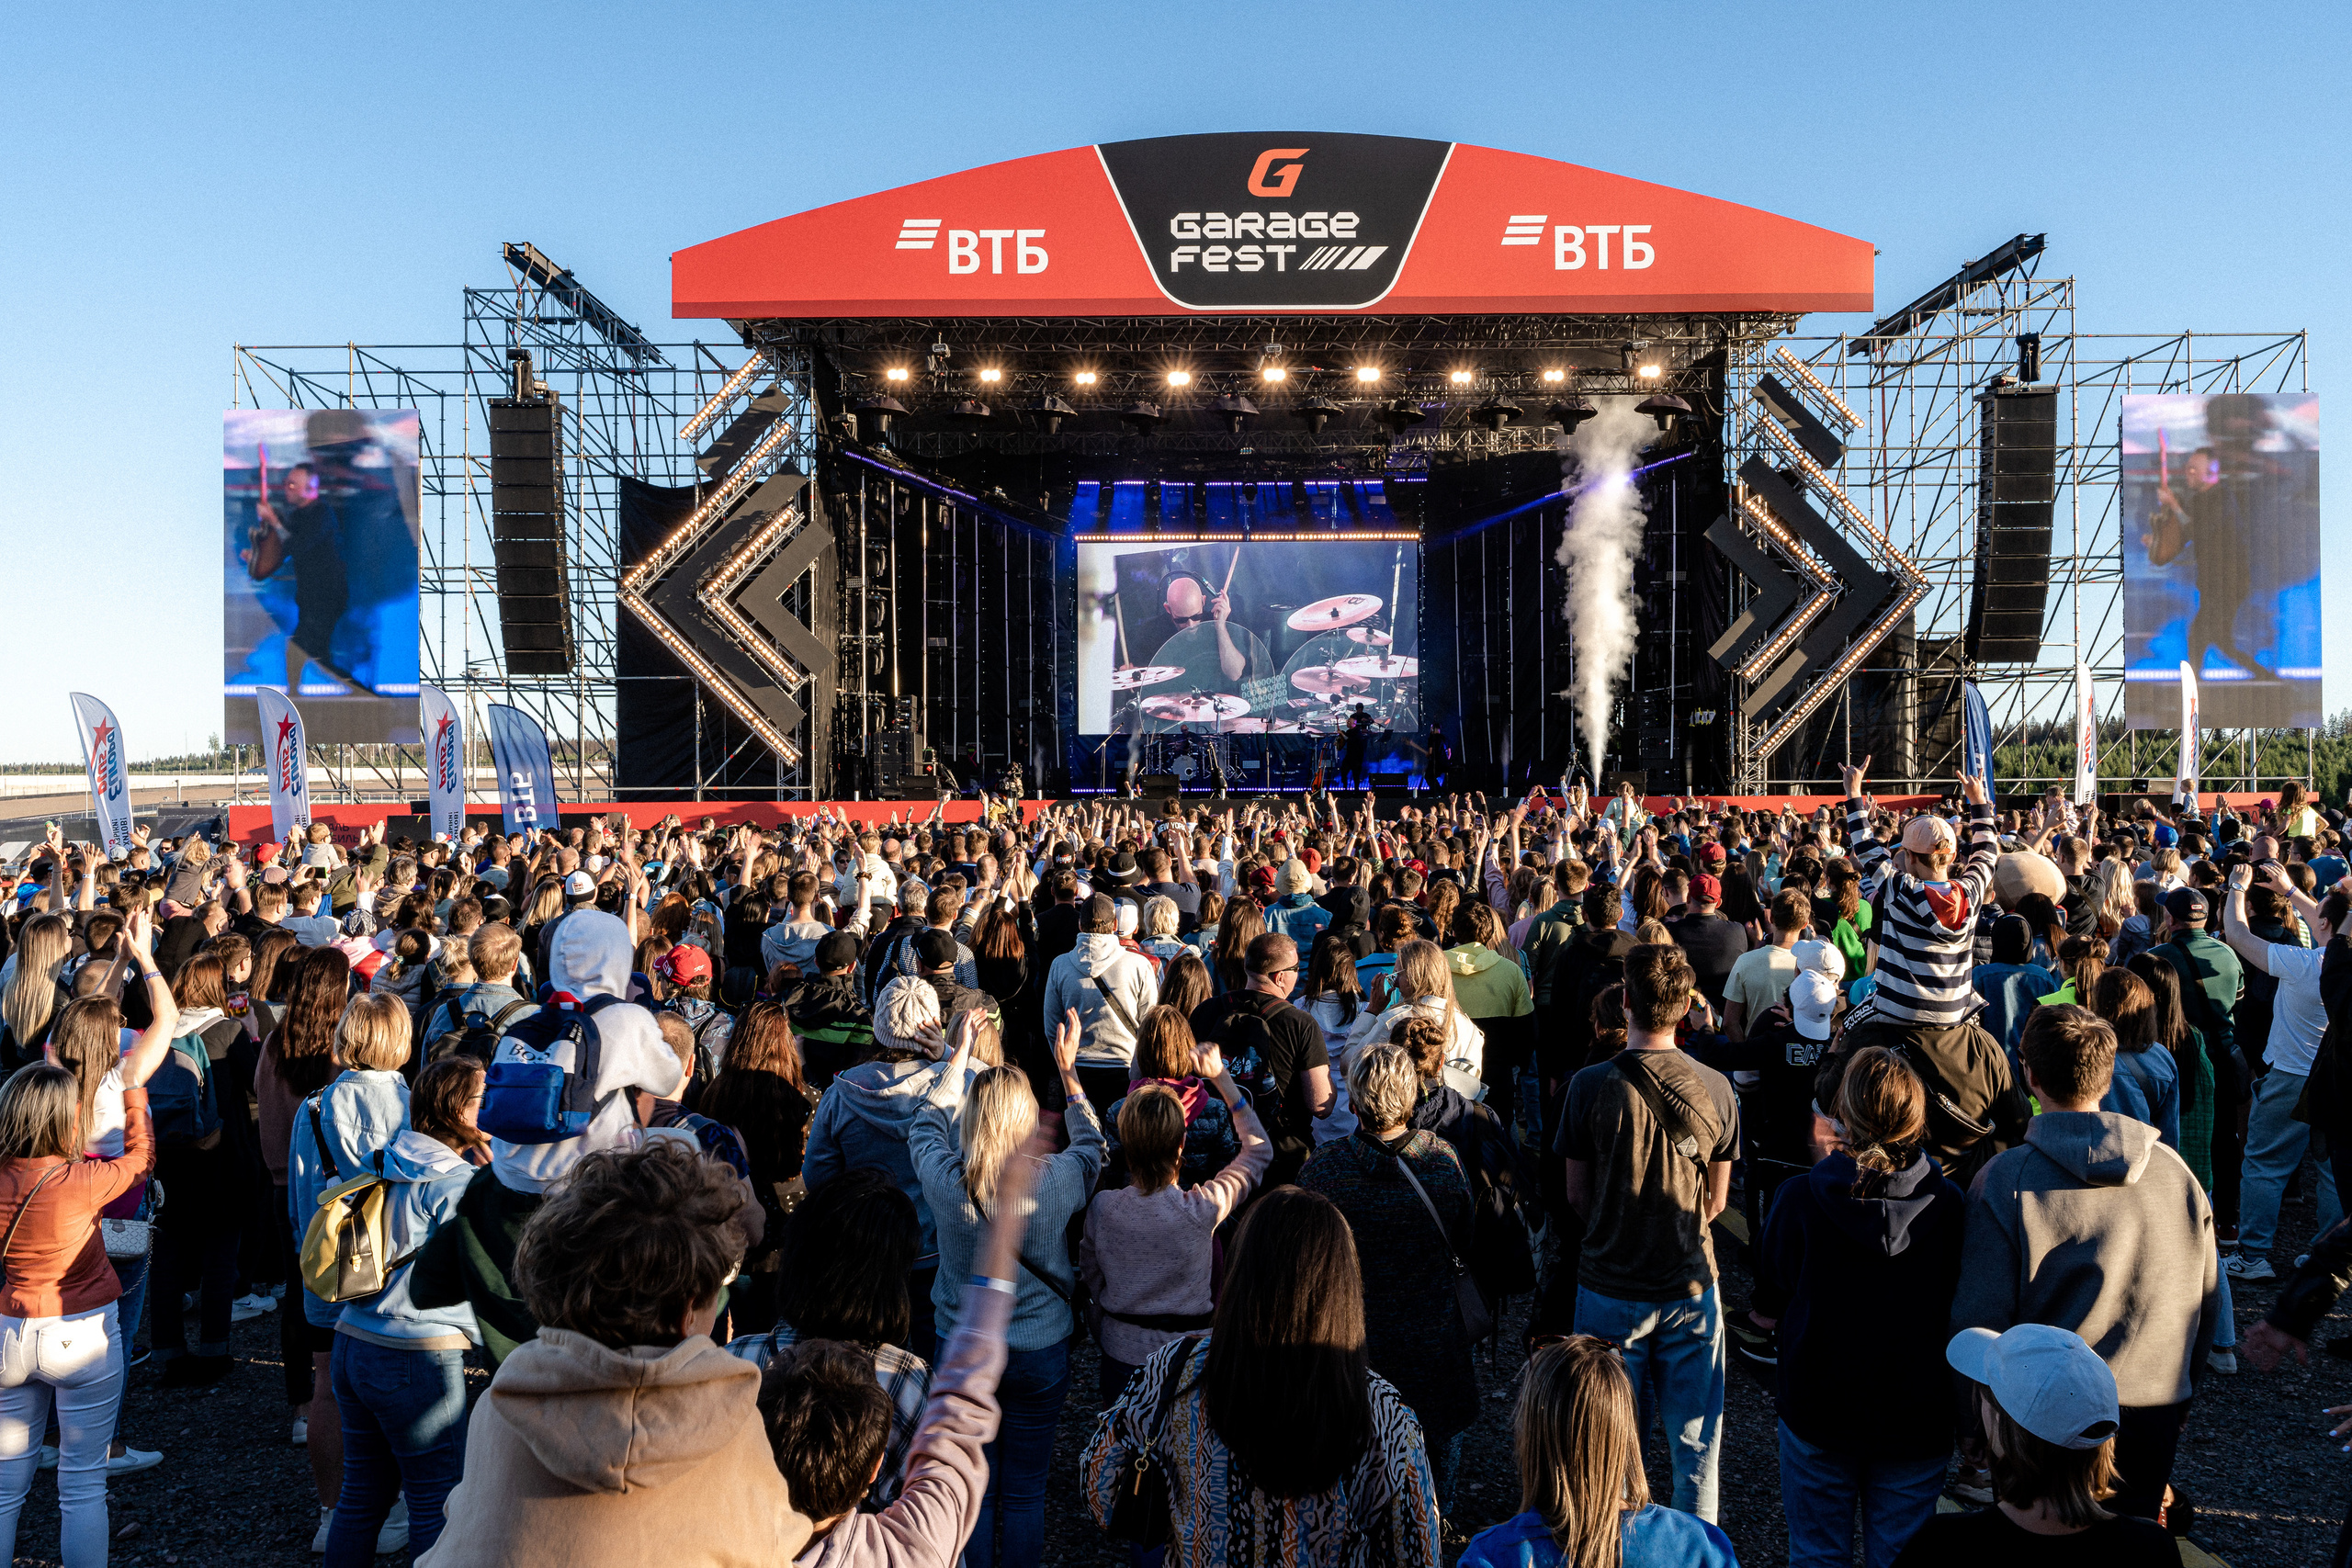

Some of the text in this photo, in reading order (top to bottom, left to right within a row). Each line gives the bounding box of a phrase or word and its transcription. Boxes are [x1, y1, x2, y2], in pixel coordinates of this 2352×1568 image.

[1247, 148, 1310, 197] G
[947, 229, 1049, 275] ВТБ
[1554, 224, 1656, 271] ВТБ
